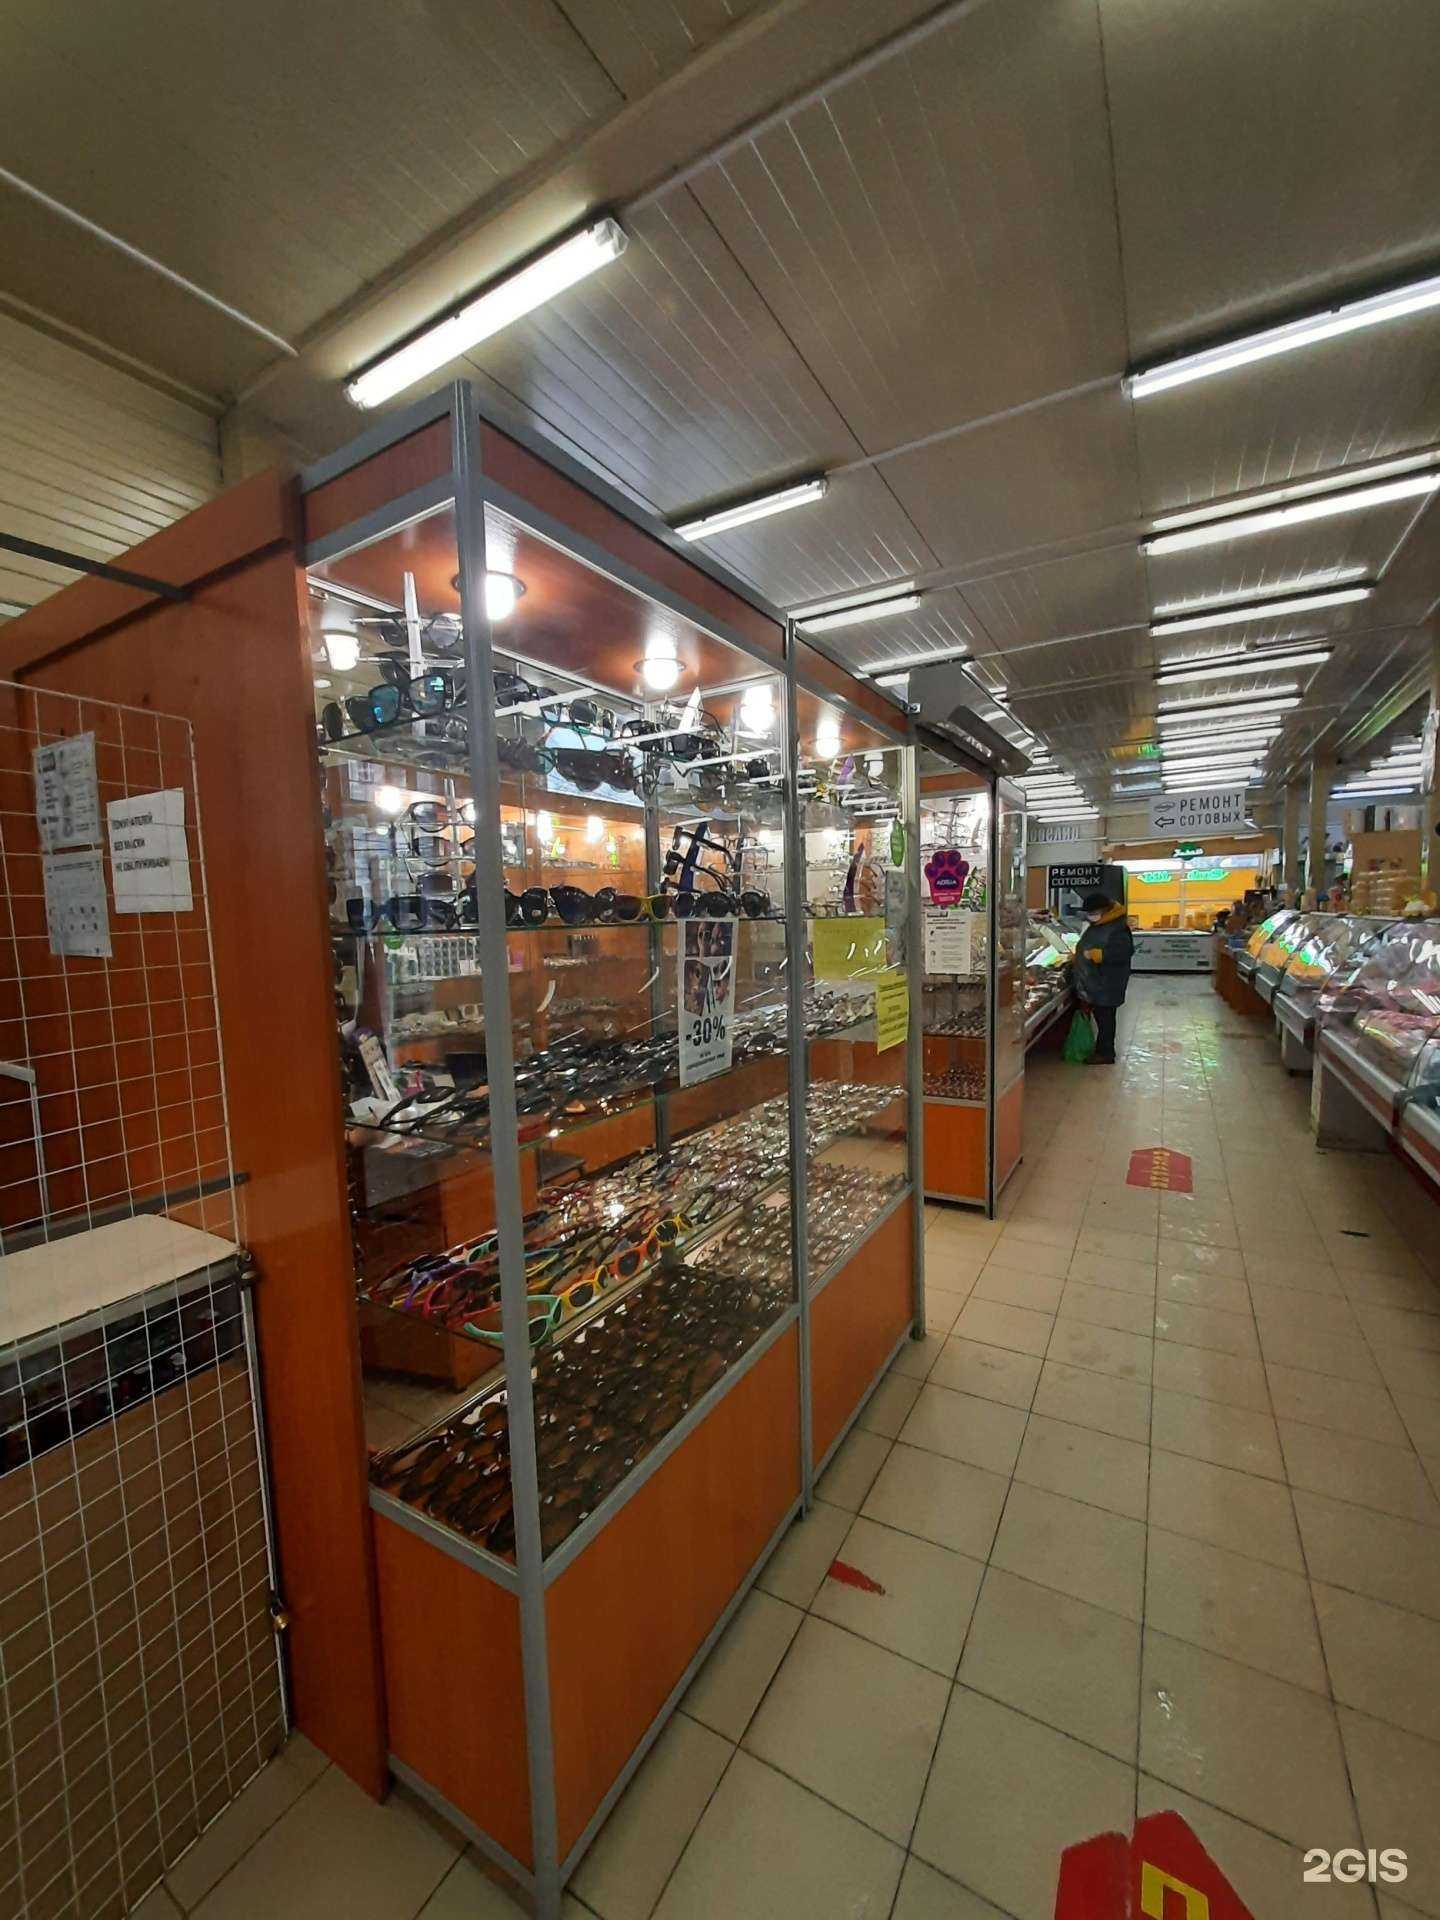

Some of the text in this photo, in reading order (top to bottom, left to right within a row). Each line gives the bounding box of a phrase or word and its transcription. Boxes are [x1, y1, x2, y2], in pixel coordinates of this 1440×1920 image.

[1180, 794, 1241, 812] РЕМОНТ
[1180, 811, 1241, 827] СОТОВЫХ
[1051, 867, 1100, 877] РЕМОНТ
[1051, 877, 1100, 886] СОТОВЫХ
[686, 1014, 726, 1047] -30%
